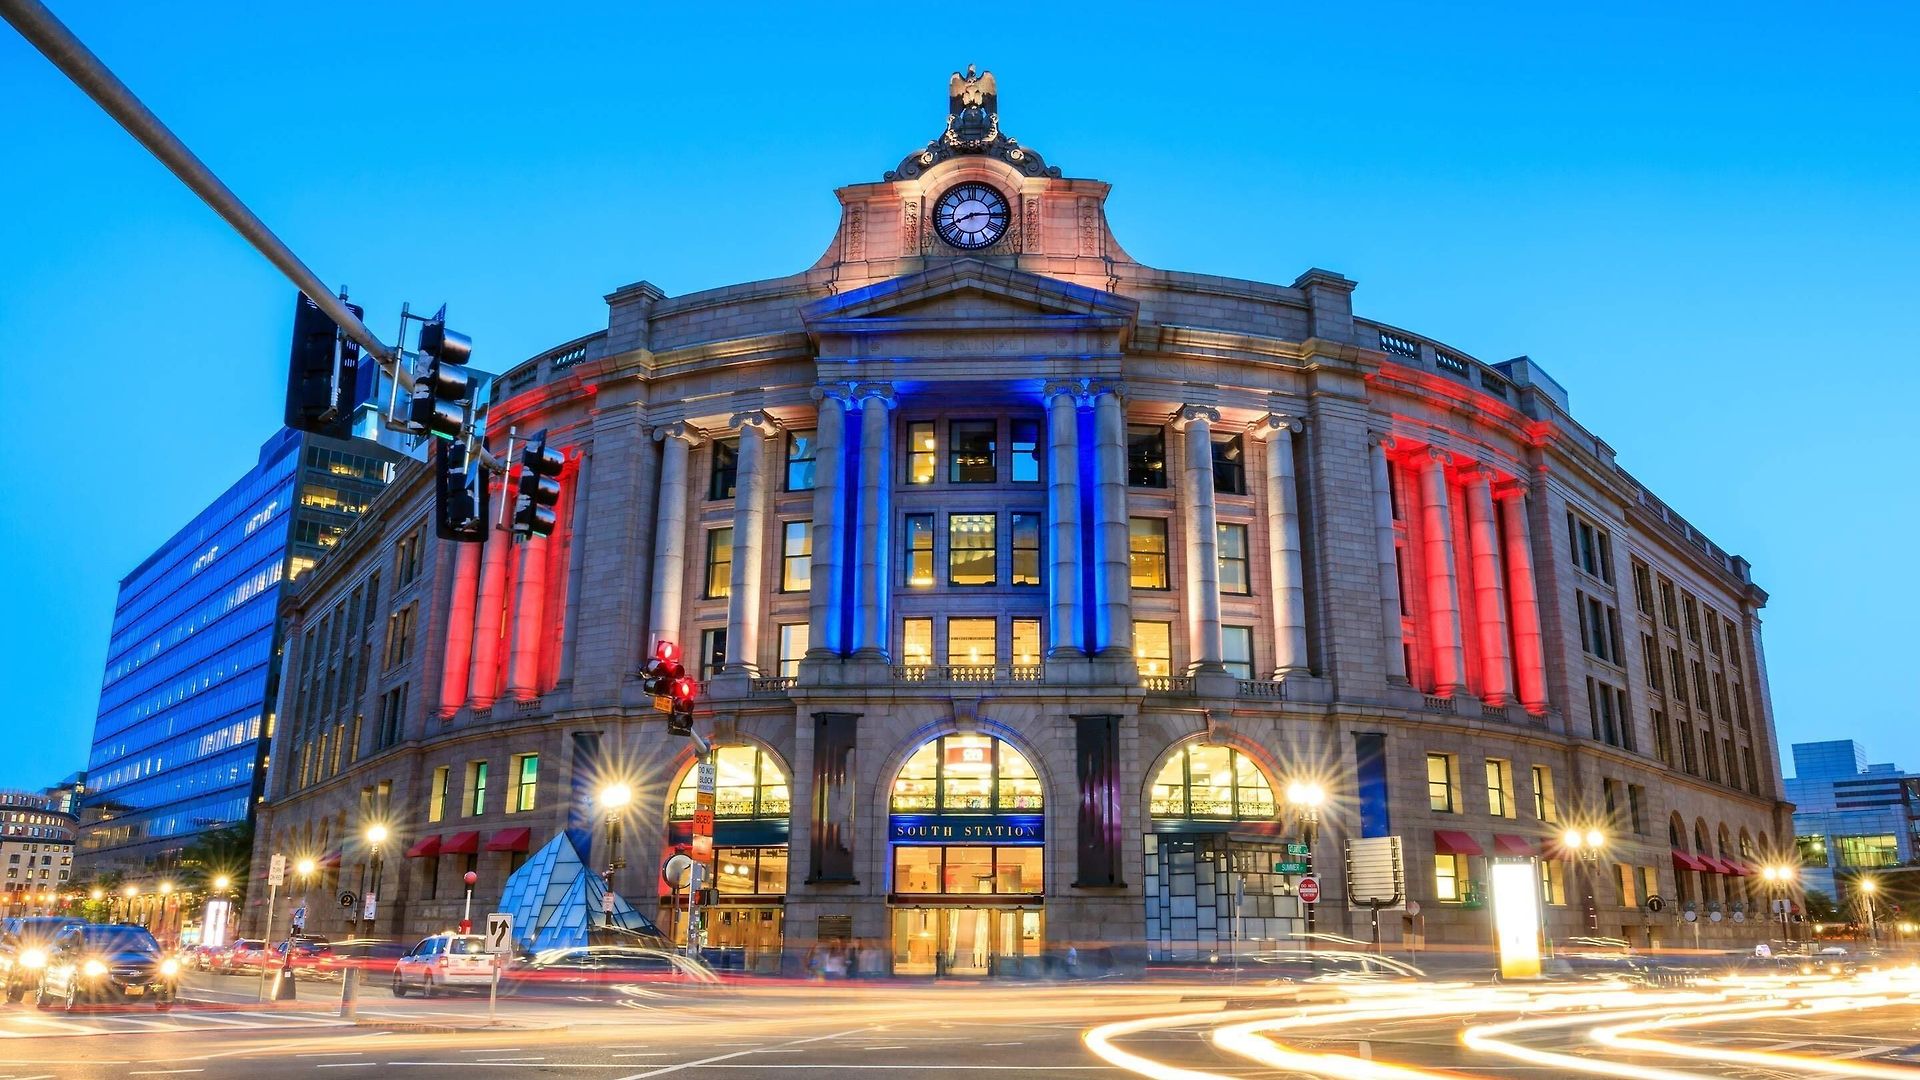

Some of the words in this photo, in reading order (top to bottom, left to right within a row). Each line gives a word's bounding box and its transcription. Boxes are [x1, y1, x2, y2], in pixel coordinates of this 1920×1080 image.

[897, 826, 952, 837] SOUTH
[964, 825, 1035, 837] STATION
[1281, 863, 1300, 871] SUMMER
[343, 896, 351, 906] 2
[1653, 900, 1658, 910] 1
